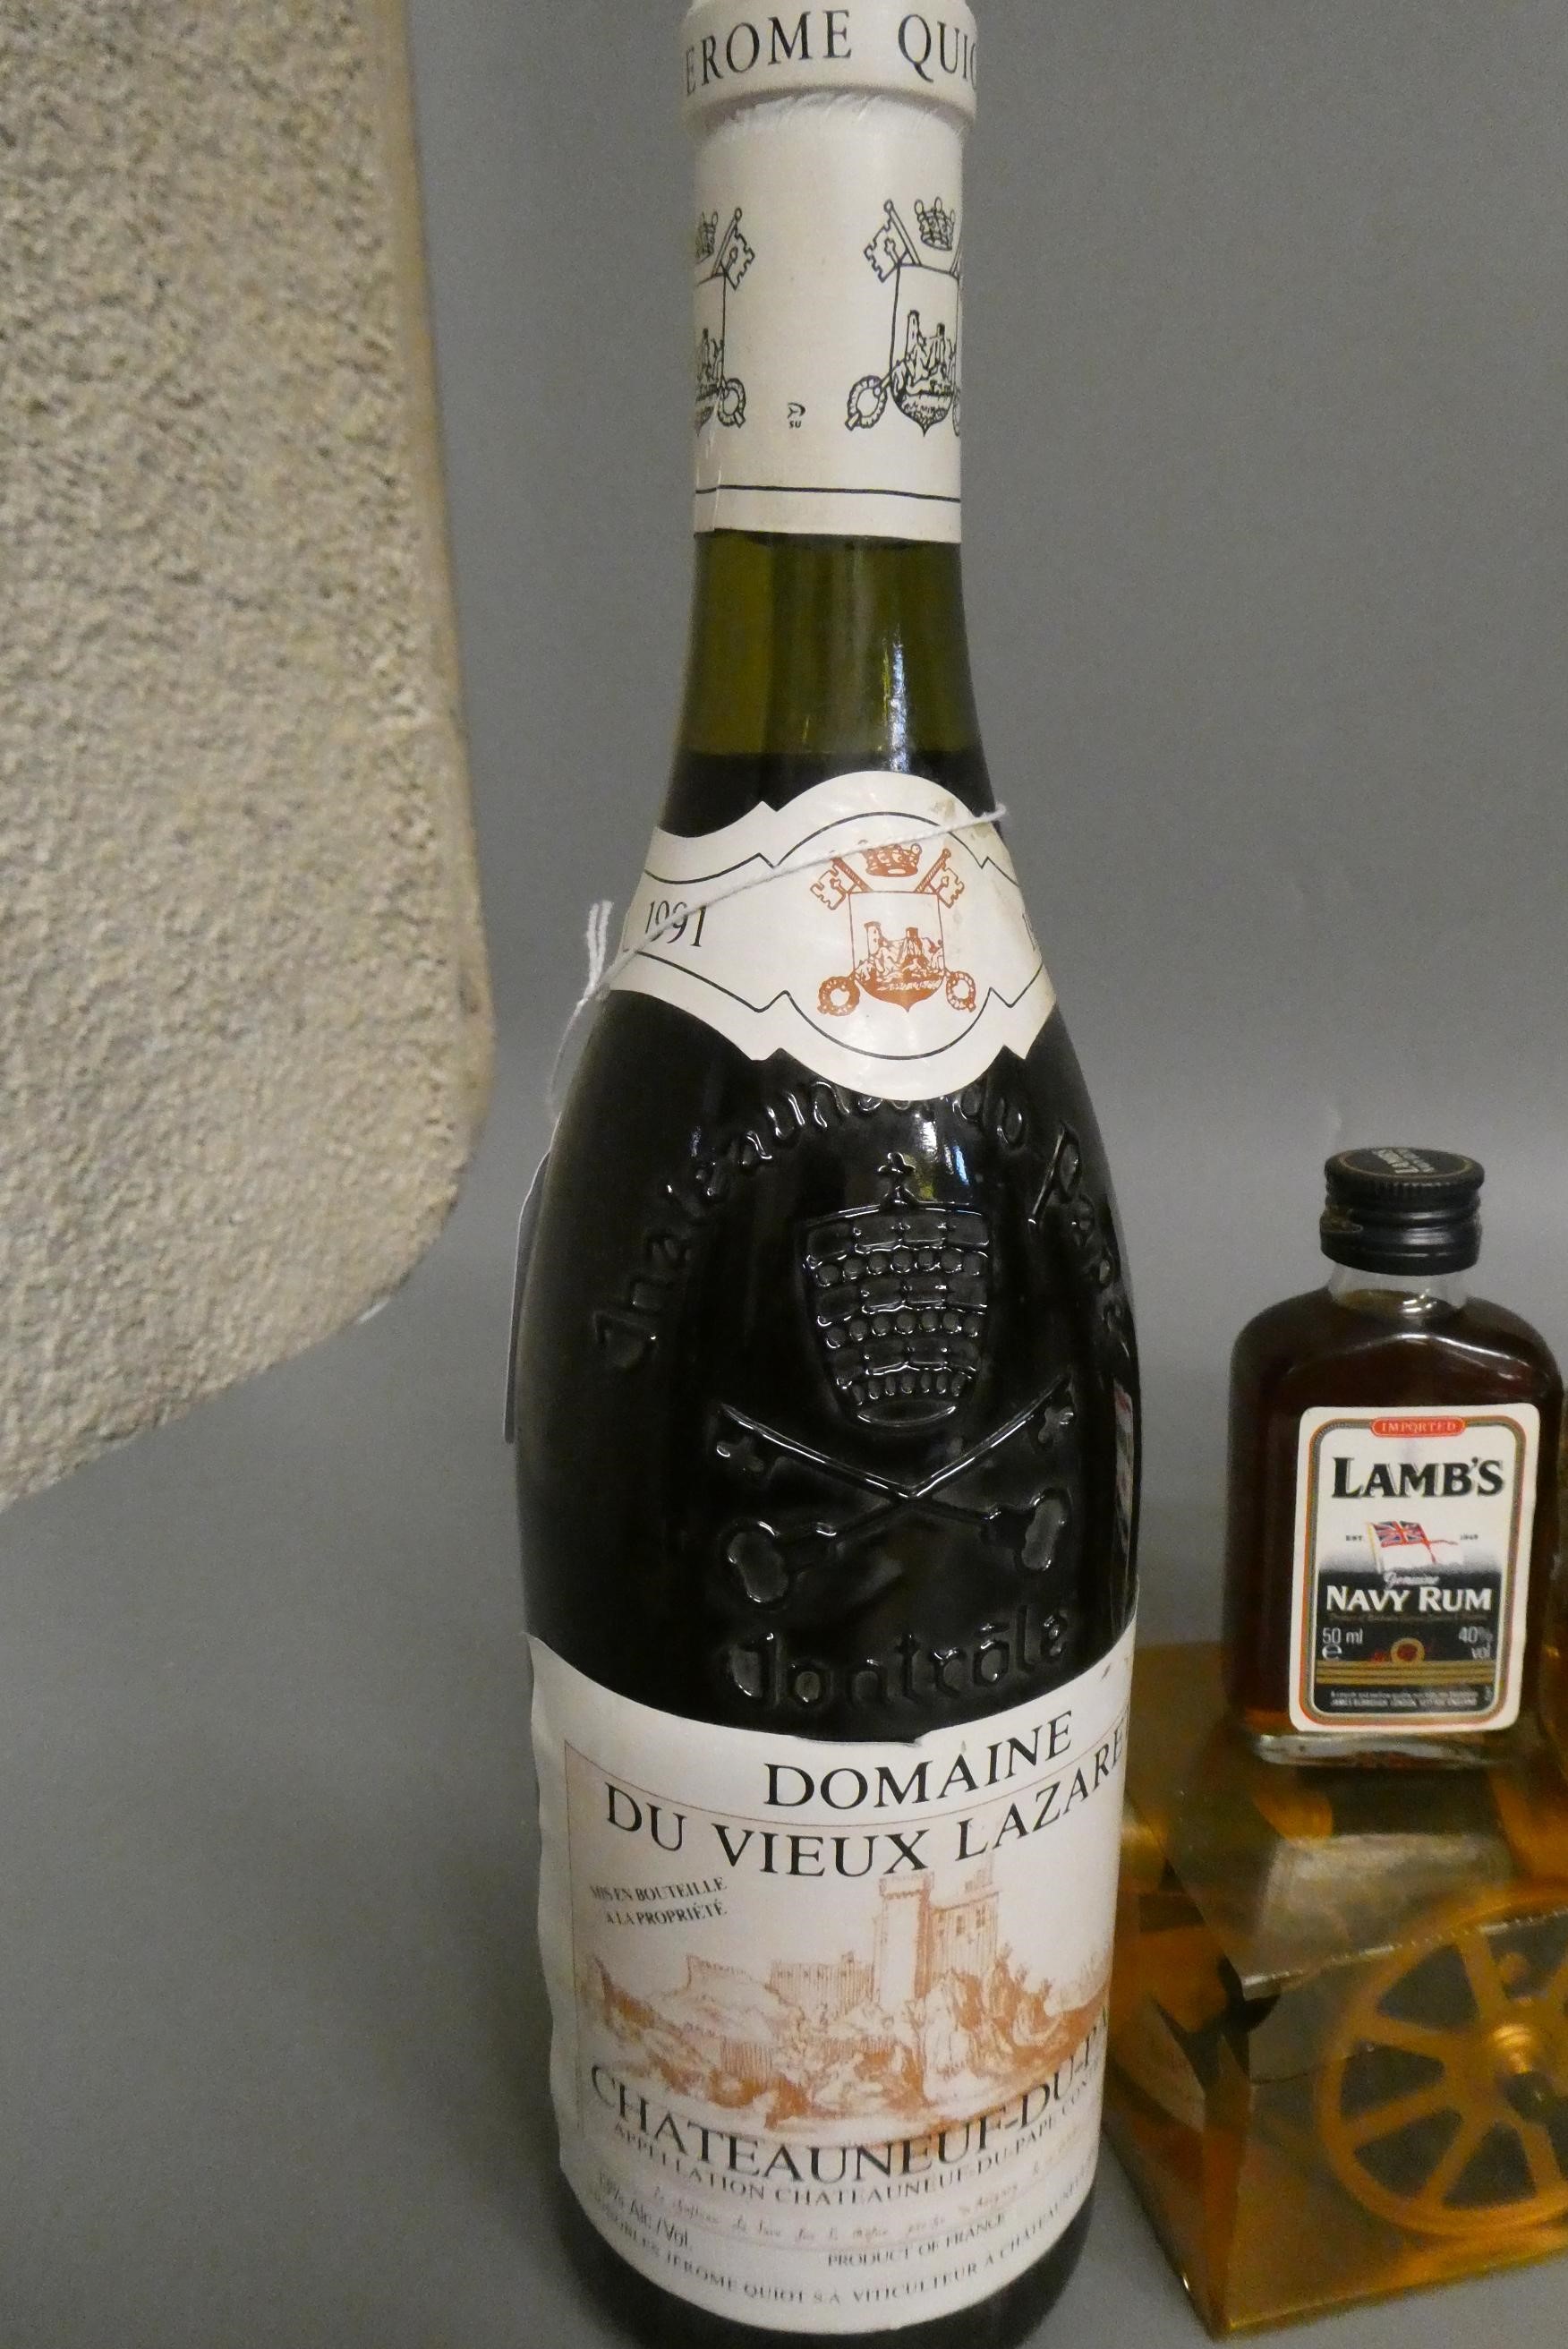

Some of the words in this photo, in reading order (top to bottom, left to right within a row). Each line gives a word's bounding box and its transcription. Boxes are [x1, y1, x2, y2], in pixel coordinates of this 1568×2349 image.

[1380, 1419, 1457, 1434] IMPORTED
[1332, 1456, 1505, 1499] LAMB'S
[1326, 1585, 1410, 1612] NAVY
[1418, 1585, 1493, 1612] RUM
[1322, 1627, 1342, 1645] 50
[1345, 1627, 1364, 1645] ml
[763, 1709, 1073, 1810] DOMAINE
[604, 1781, 686, 1852] DU
[712, 1823, 931, 1877] VIEUX
[635, 1876, 728, 1902] BOUTEILLE
